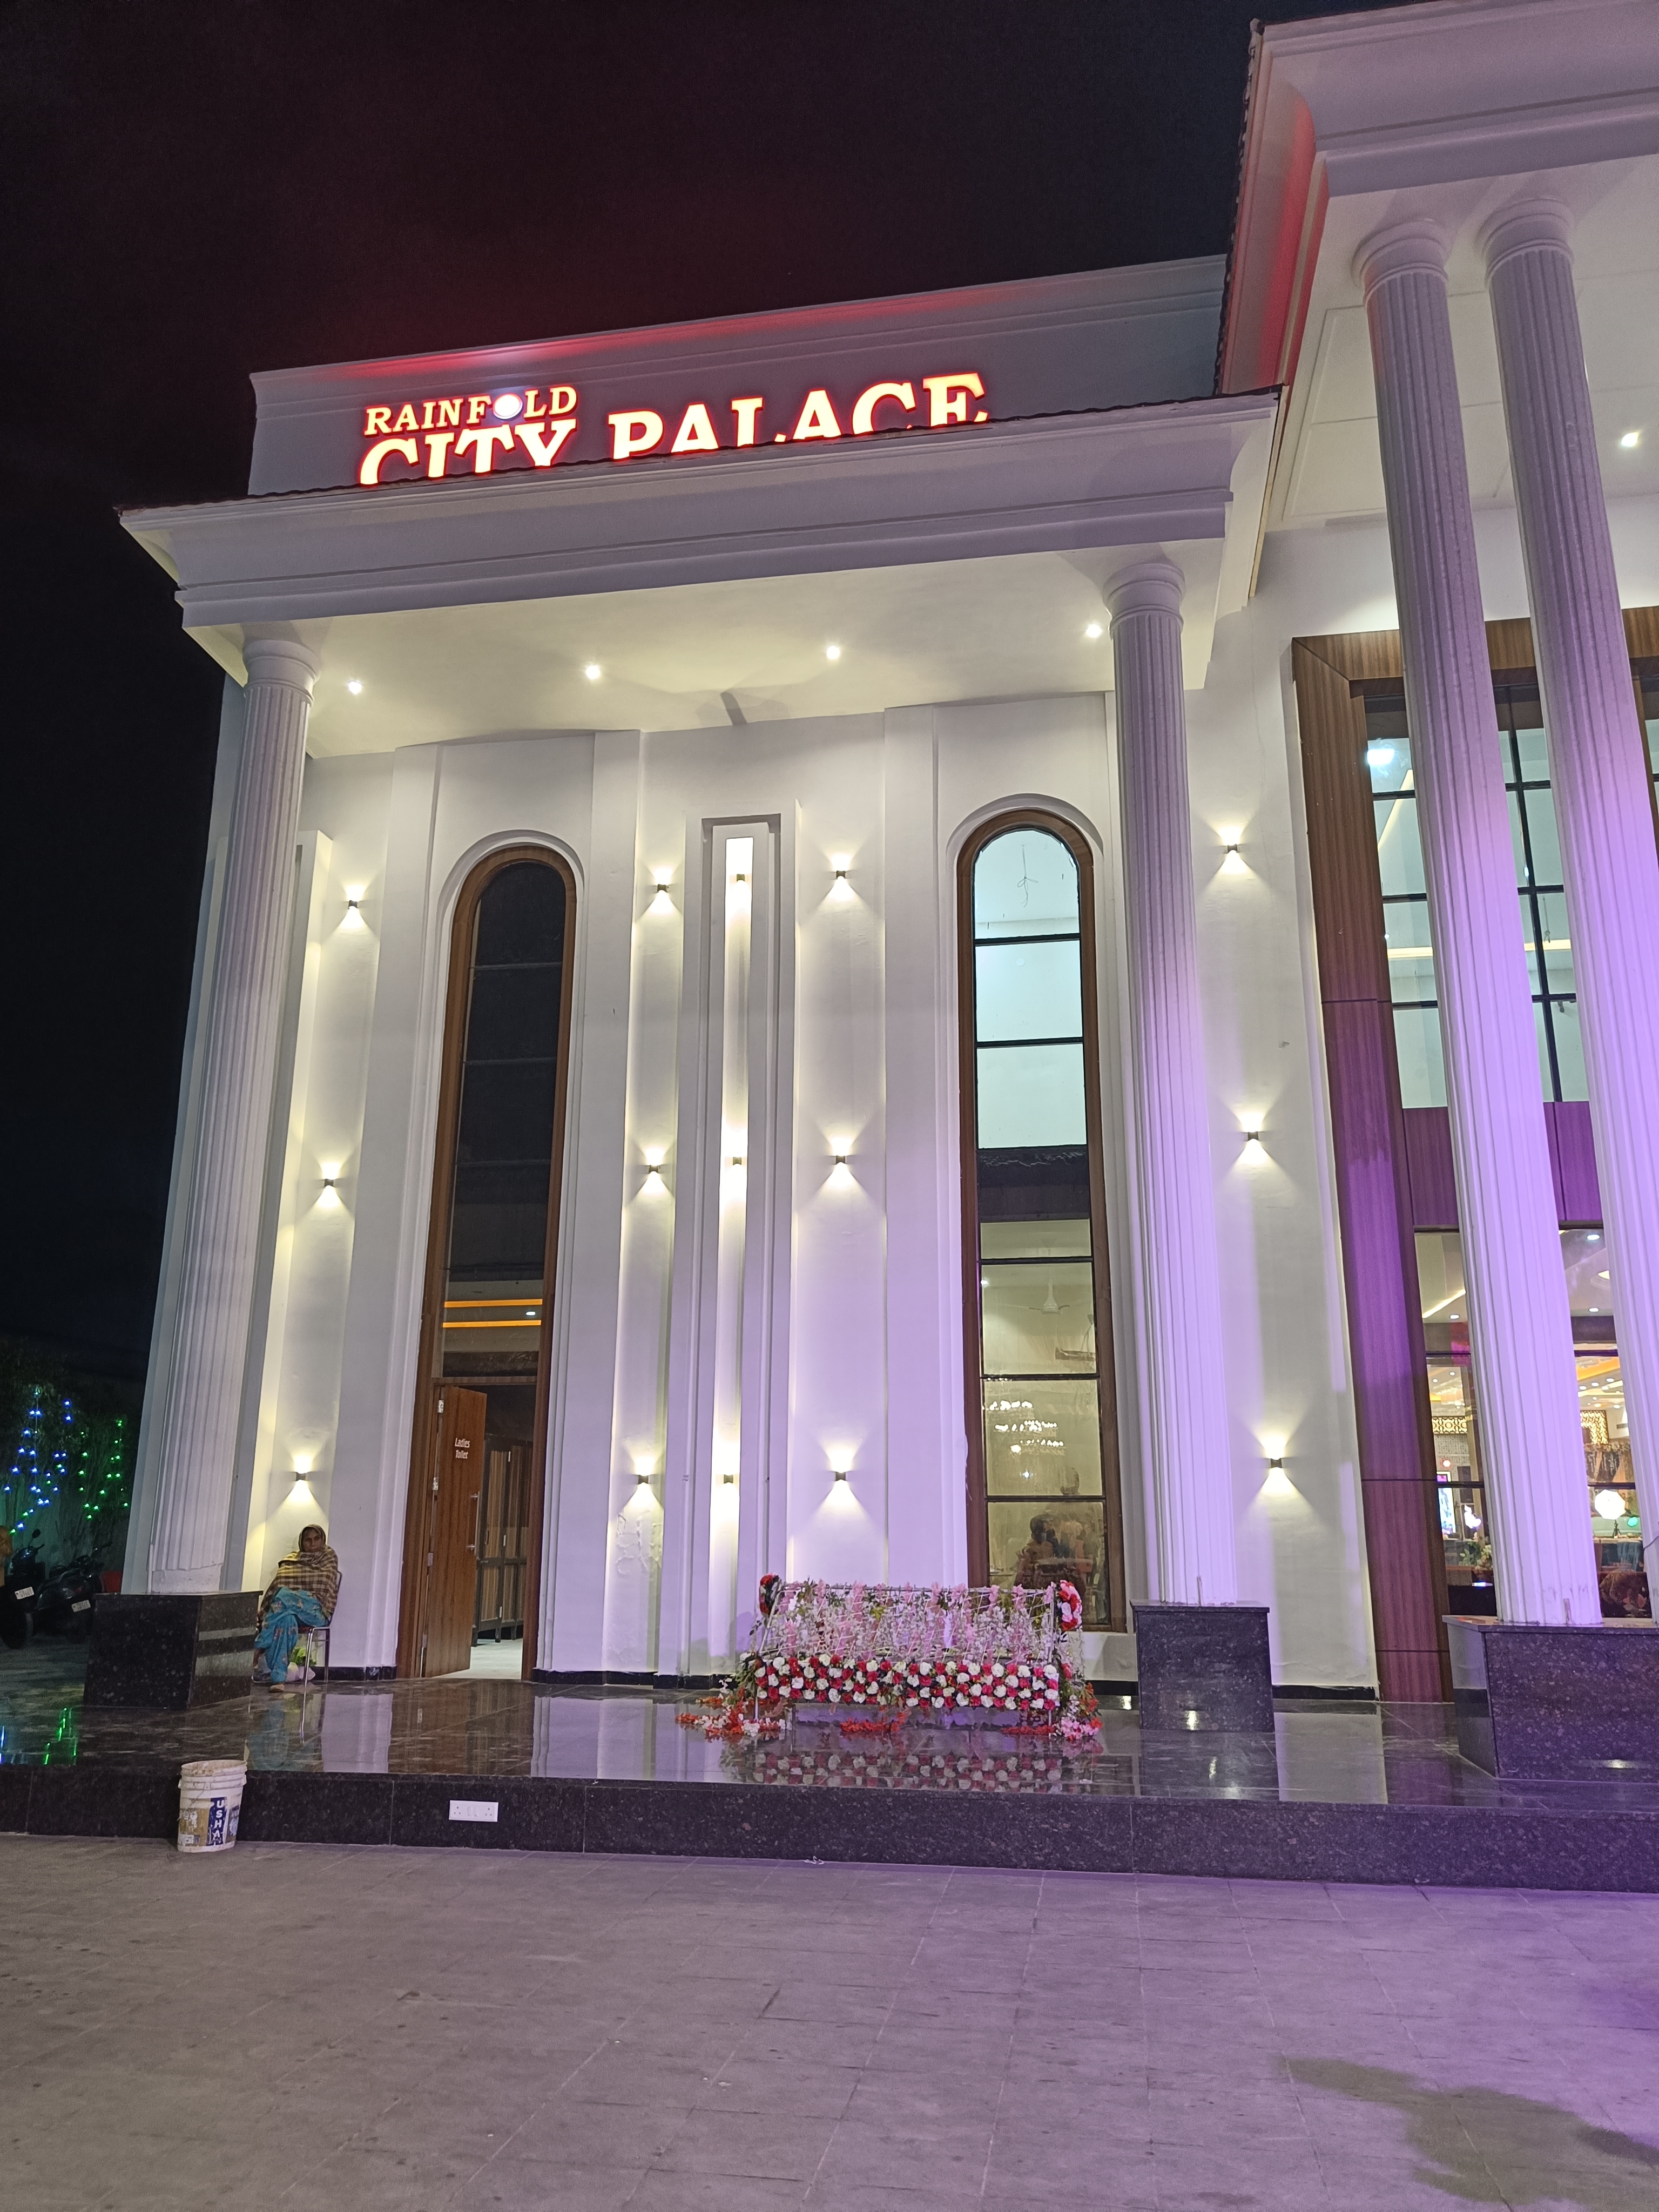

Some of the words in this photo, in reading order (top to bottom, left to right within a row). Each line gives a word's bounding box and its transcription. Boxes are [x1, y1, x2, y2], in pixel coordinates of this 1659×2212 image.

[360, 418, 577, 485] CITY
[608, 372, 988, 461] PALACE
[363, 386, 578, 436] RAINFOLD
[455, 1438, 470, 1448] Ladies
[455, 1449, 468, 1459] Toilet
[213, 1800, 225, 1840] USHA
